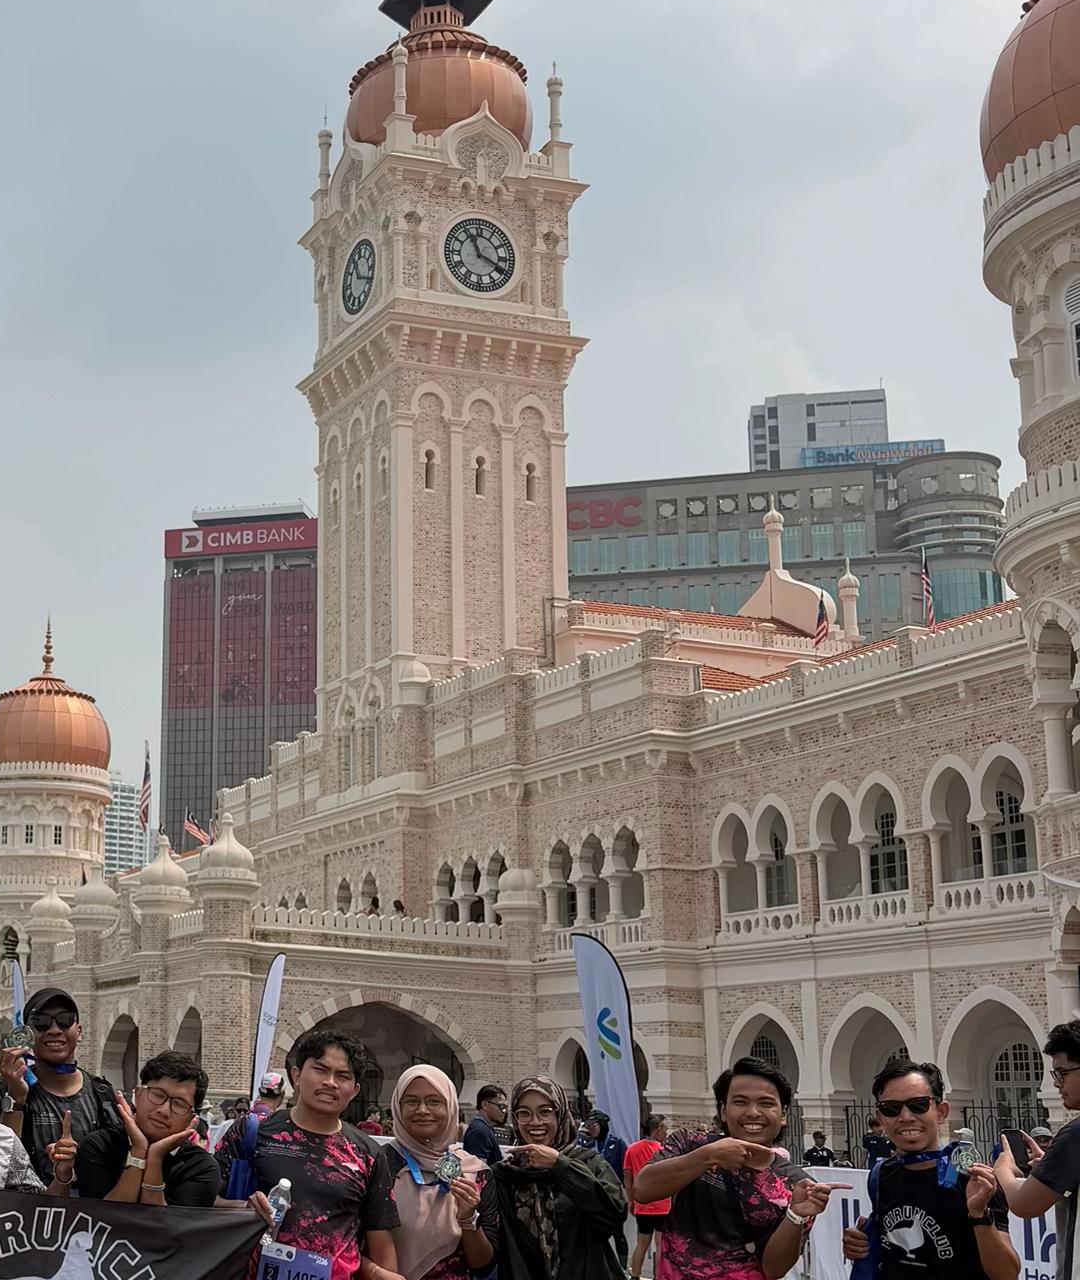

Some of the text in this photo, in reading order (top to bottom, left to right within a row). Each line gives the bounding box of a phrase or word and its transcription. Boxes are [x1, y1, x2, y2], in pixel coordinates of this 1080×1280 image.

[816, 448, 857, 463] Bank
[207, 526, 305, 547] CIMB BANK
[266, 1268, 274, 1280] 2
